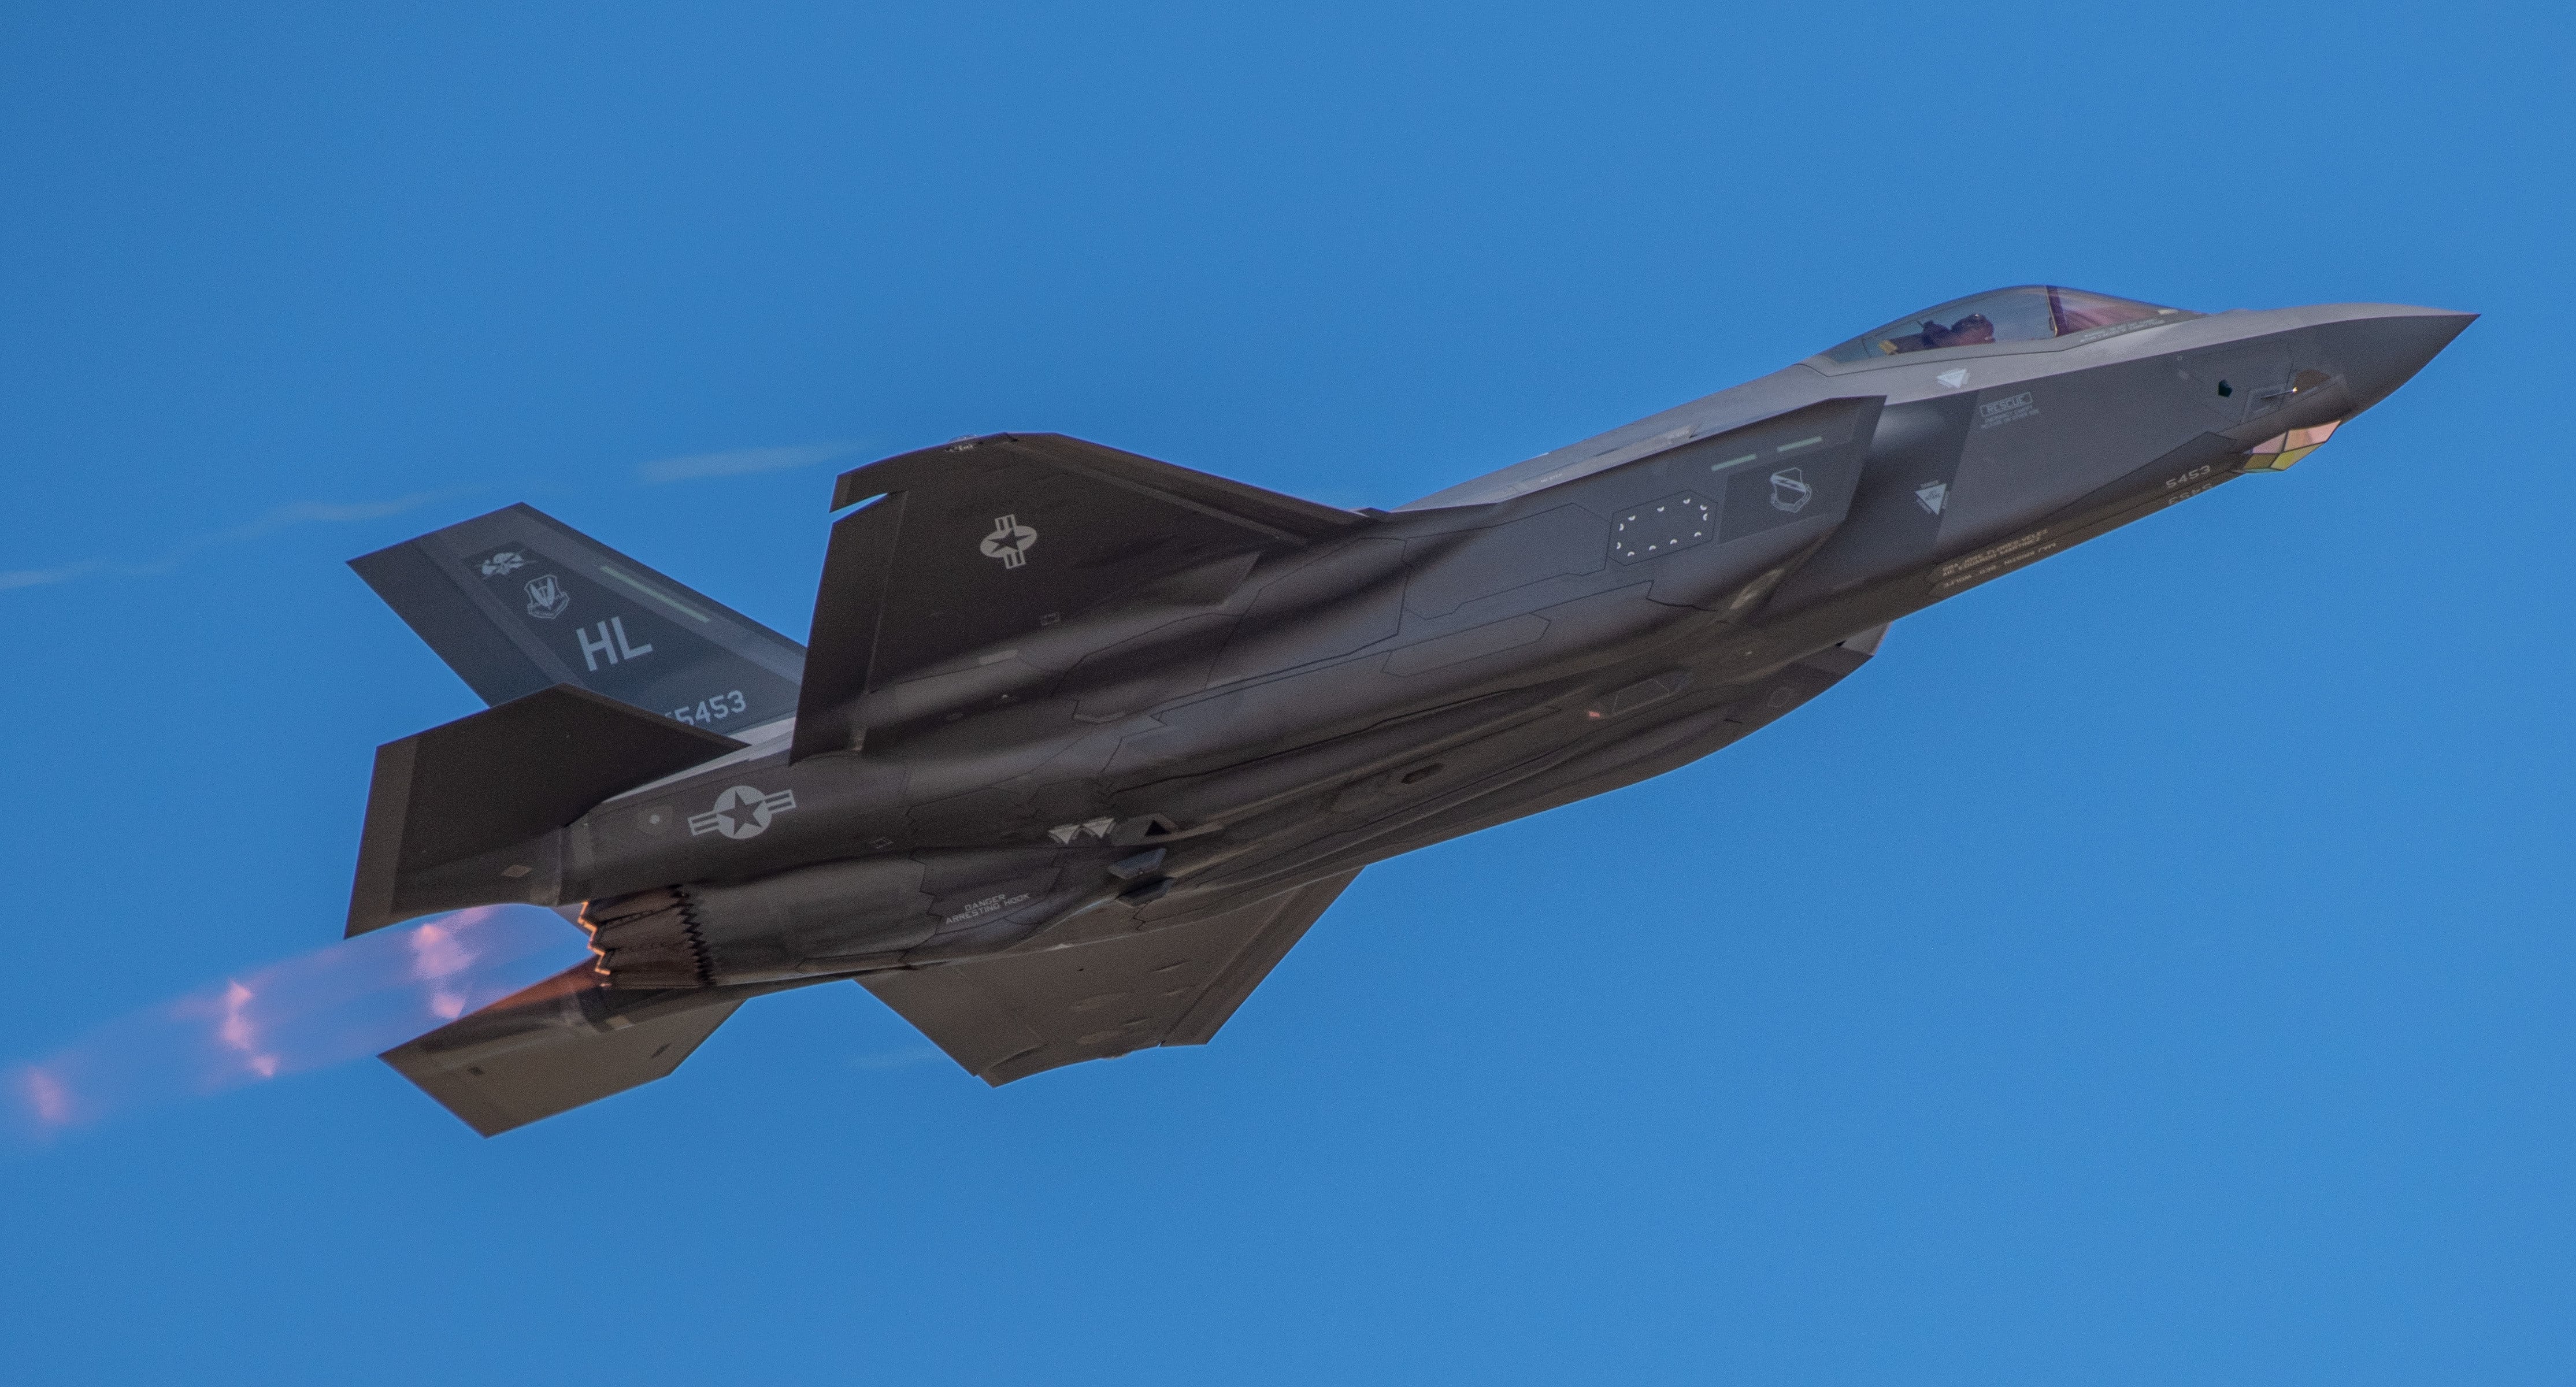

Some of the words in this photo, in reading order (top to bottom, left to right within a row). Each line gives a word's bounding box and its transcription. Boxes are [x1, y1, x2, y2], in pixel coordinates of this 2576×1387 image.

[1987, 394, 2027, 414] RESCUE
[2166, 465, 2211, 488] 5453
[576, 616, 653, 672] HL
[665, 690, 746, 726] 5453
[946, 902, 1000, 925] ARRESTING
[1003, 893, 1030, 906] HOOK
[965, 894, 1006, 911] DANGER
